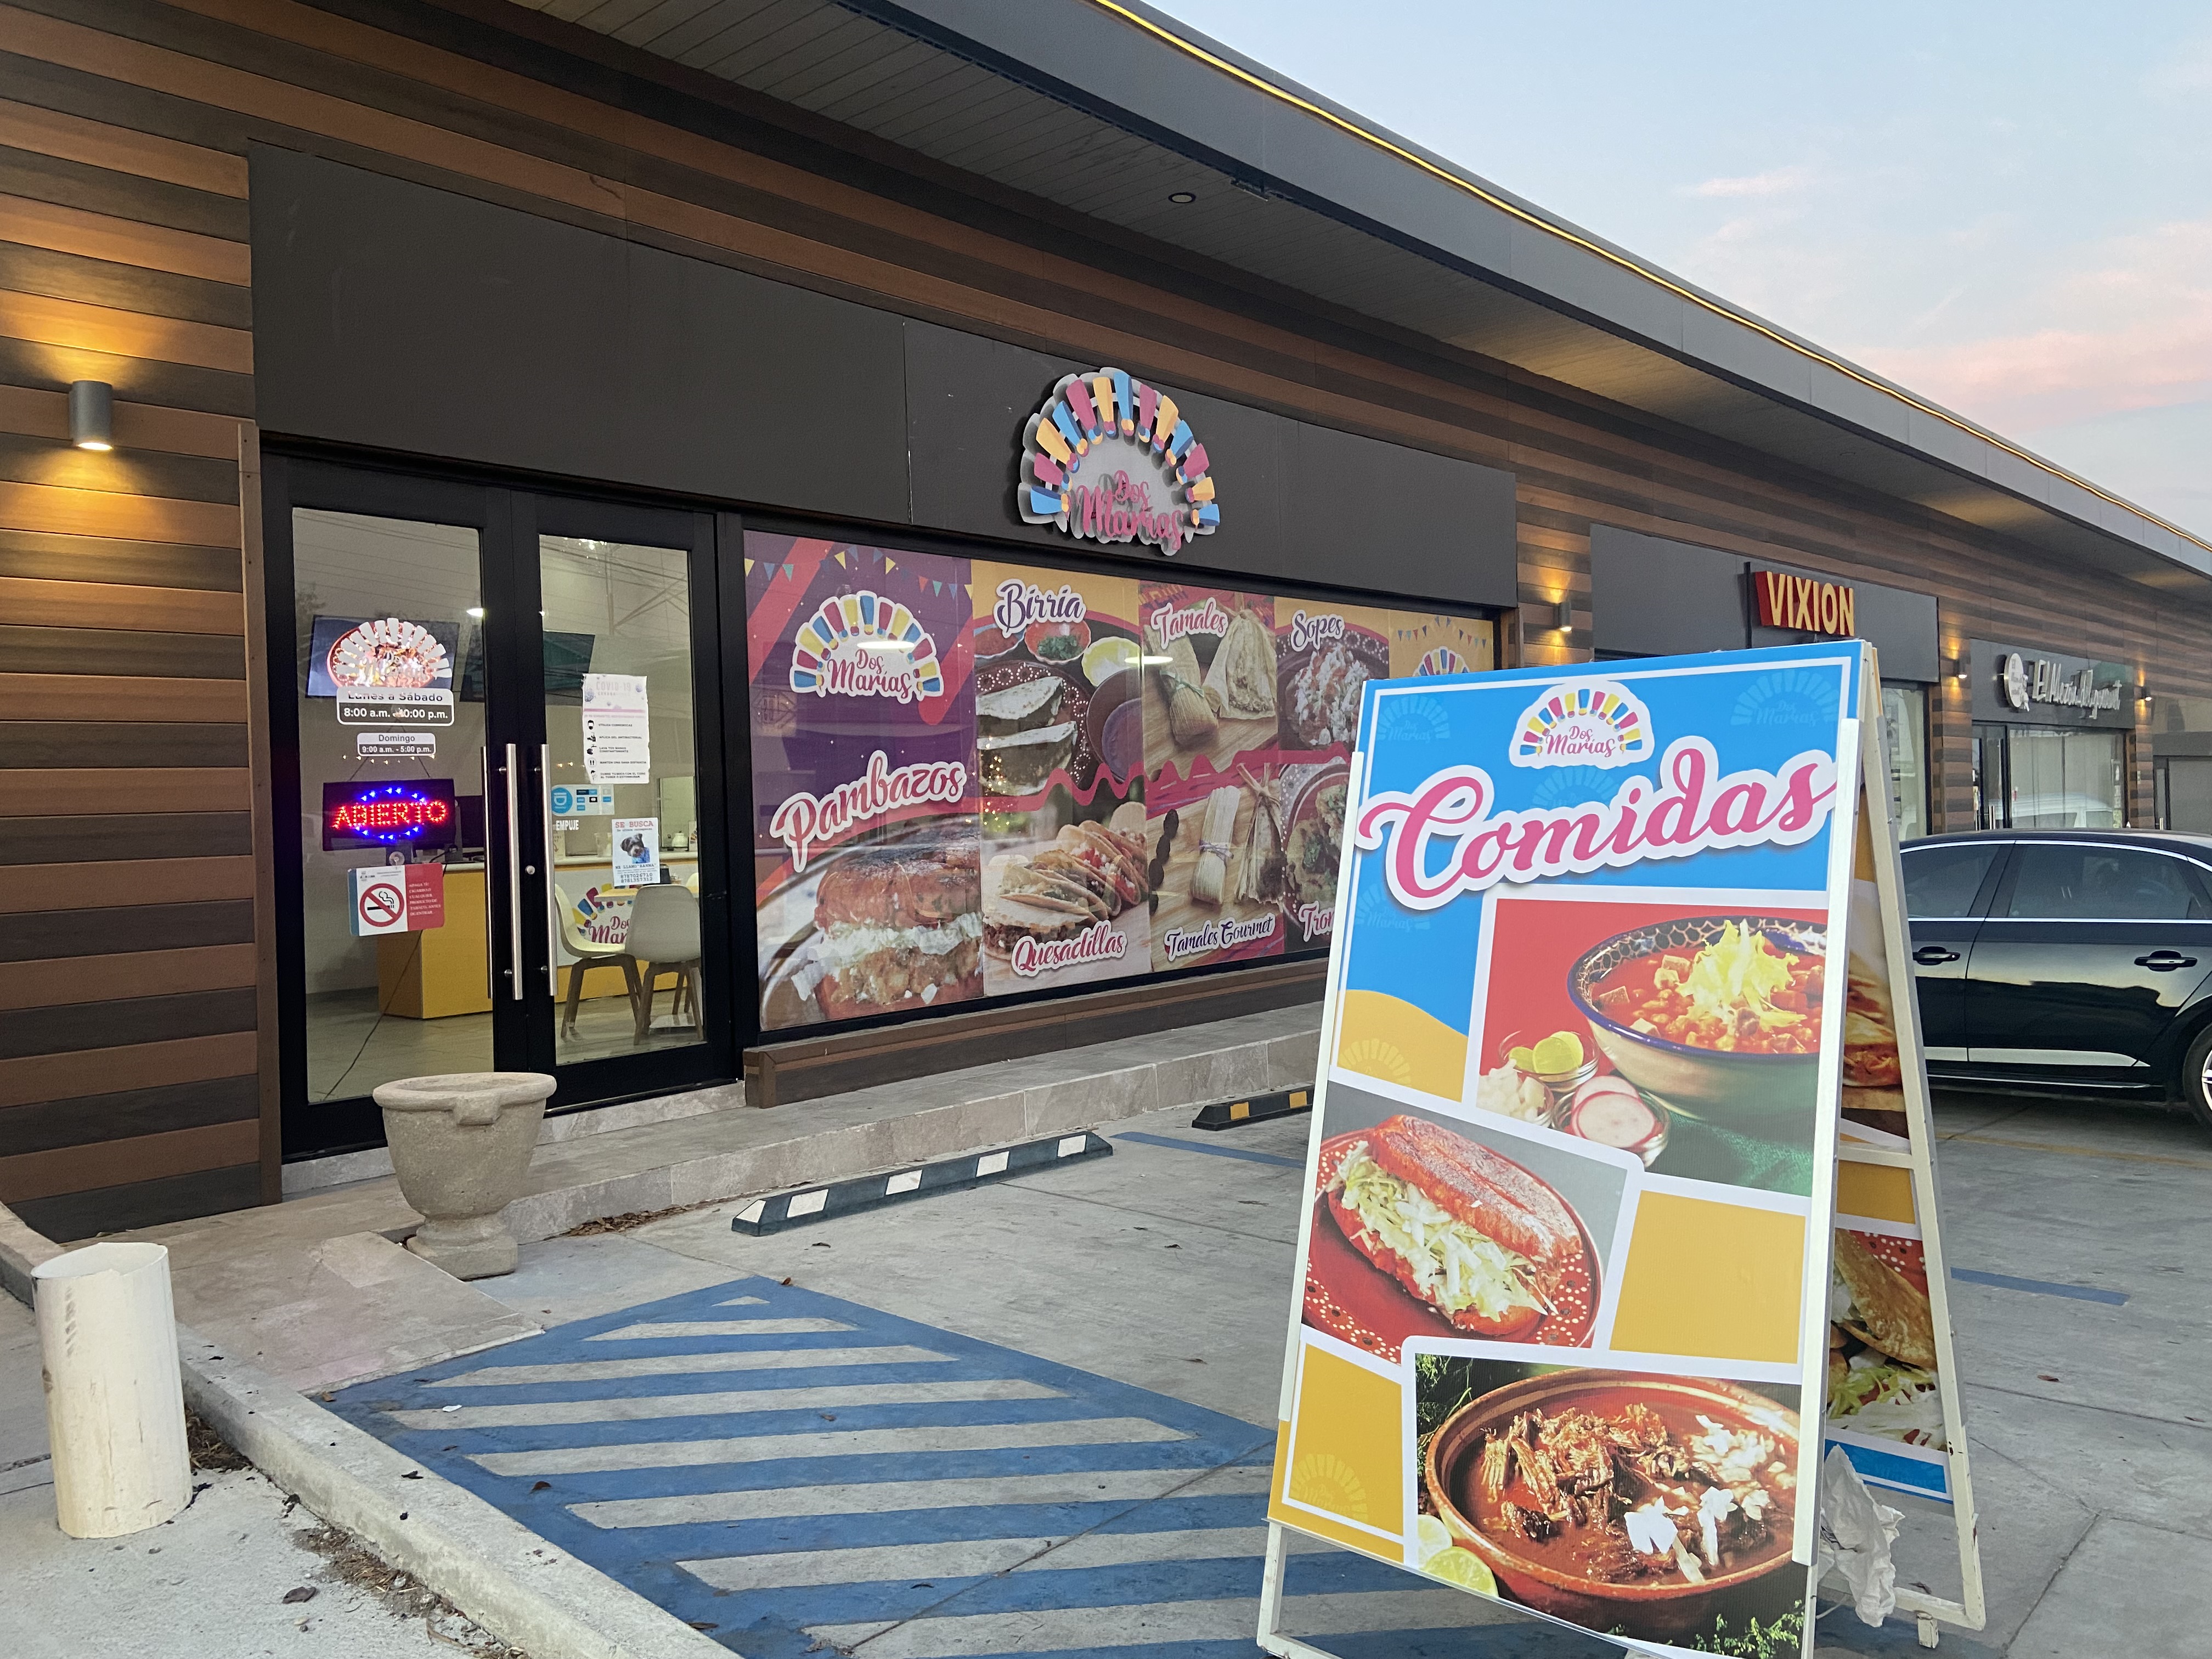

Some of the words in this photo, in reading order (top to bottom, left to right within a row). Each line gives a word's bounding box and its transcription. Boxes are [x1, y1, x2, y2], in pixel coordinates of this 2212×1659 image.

[1114, 470, 1150, 510] Dos
[997, 583, 1083, 633] Birria
[1767, 571, 1854, 636] VIXION
[1154, 600, 1227, 645] Tamales
[1294, 613, 1342, 647] Sopes
[855, 649, 884, 674] Dos
[596, 681, 631, 691] COVID-19
[827, 659, 912, 699] Marías
[343, 708, 367, 717] 8:00
[428, 711, 448, 720] p.m.
[348, 692, 384, 700] Lunes
[399, 692, 443, 702] Sábado
[379, 735, 415, 743] Domingo
[1545, 733, 1616, 758] Marías
[1569, 726, 1593, 742] Dos
[332, 800, 448, 829] ABIERTO
[556, 820, 579, 831] EMPUJE
[775, 756, 963, 867] Pambazos
[1358, 748, 1837, 898] Comidas
[1015, 923, 1124, 972] Quesadillas
[1167, 923, 1218, 958] Tamales
[1221, 917, 1273, 947] Gourmet
